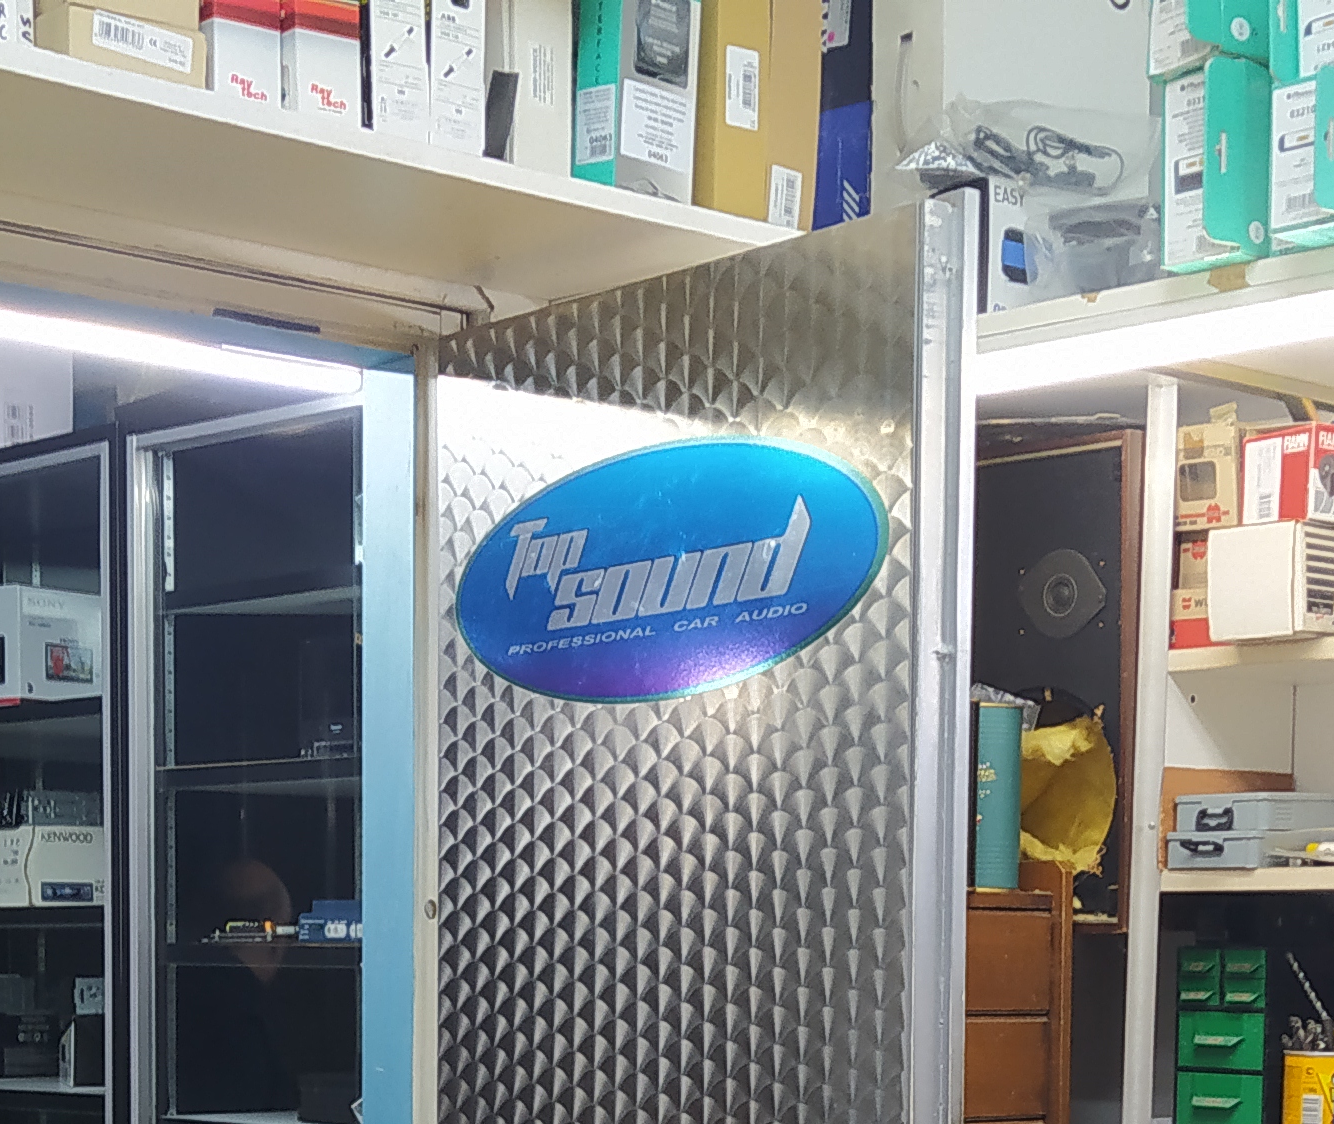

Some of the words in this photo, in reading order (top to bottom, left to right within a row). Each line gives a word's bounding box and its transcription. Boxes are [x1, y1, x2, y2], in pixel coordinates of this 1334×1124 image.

[993, 184, 1026, 208] EASY
[505, 515, 589, 602] Top
[507, 624, 657, 658] PROFESSIONAL
[672, 613, 719, 634] CAR
[734, 601, 809, 625] AUDIO
[40, 830, 94, 844] KENWOOD
